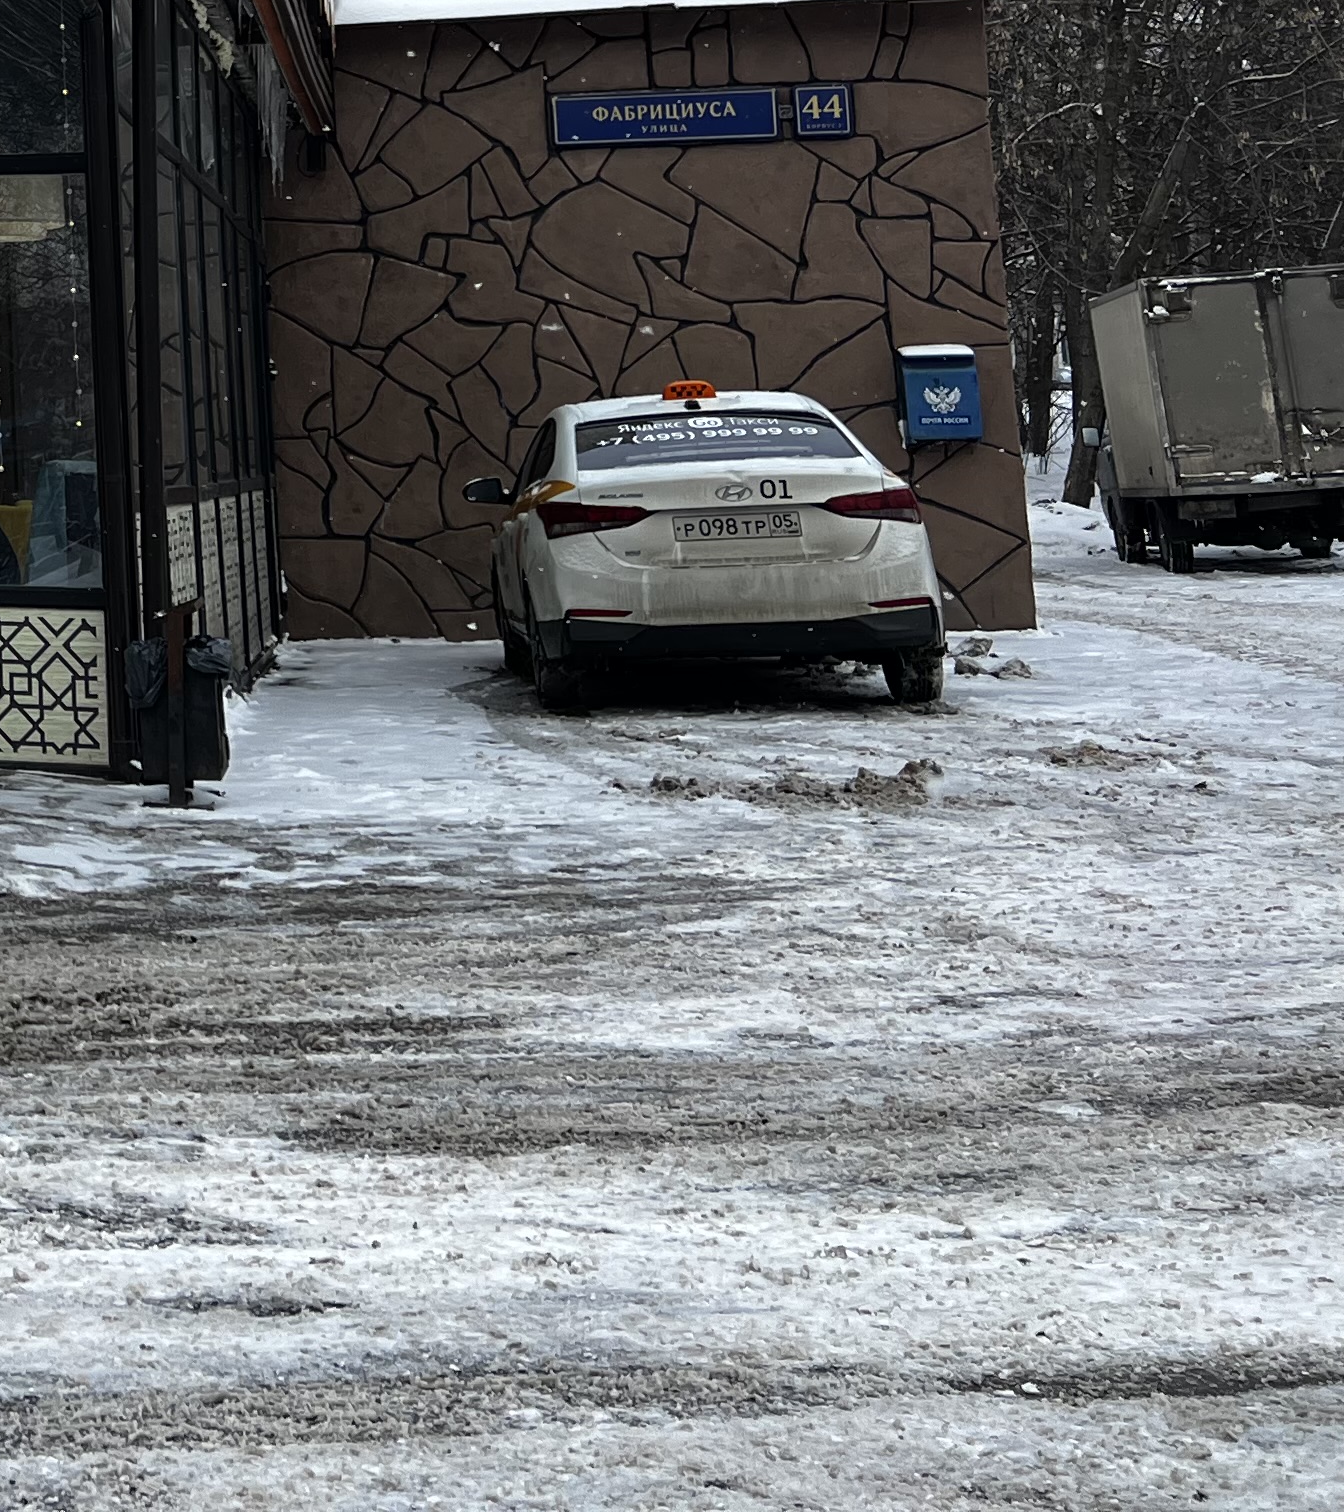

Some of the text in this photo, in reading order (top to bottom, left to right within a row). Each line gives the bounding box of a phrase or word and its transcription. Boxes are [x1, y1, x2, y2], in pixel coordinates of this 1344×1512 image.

[591, 100, 737, 122] ФАБРИЦИУСА
[801, 94, 844, 120] 44
[617, 420, 684, 434] Яндекс
[730, 417, 779, 426] Такси
[596, 426, 820, 447] +7 (495) 999 99 99
[759, 479, 793, 499] 01
